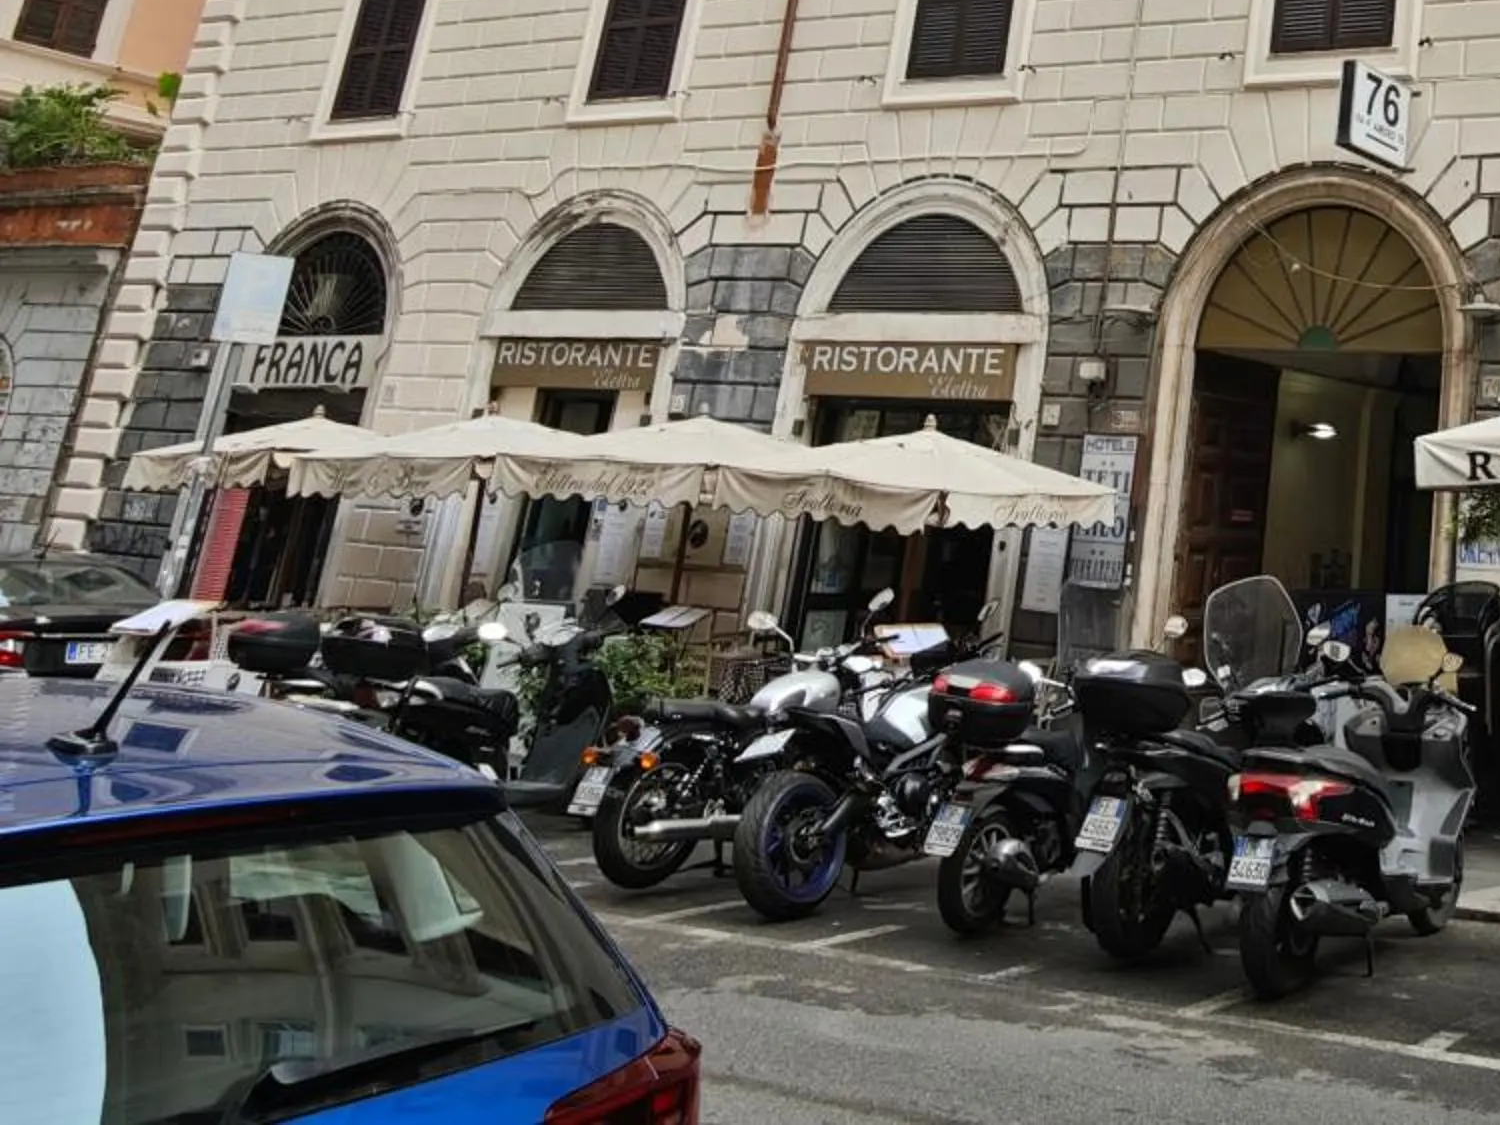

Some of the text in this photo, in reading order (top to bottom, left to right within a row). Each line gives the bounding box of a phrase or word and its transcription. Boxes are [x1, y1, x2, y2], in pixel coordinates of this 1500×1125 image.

[1366, 71, 1401, 128] 76
[249, 340, 364, 384] FRANCA
[498, 341, 654, 368] RISTORANTE
[812, 345, 1006, 375] RISTORANTE
[1086, 440, 1137, 452] HOTELS
